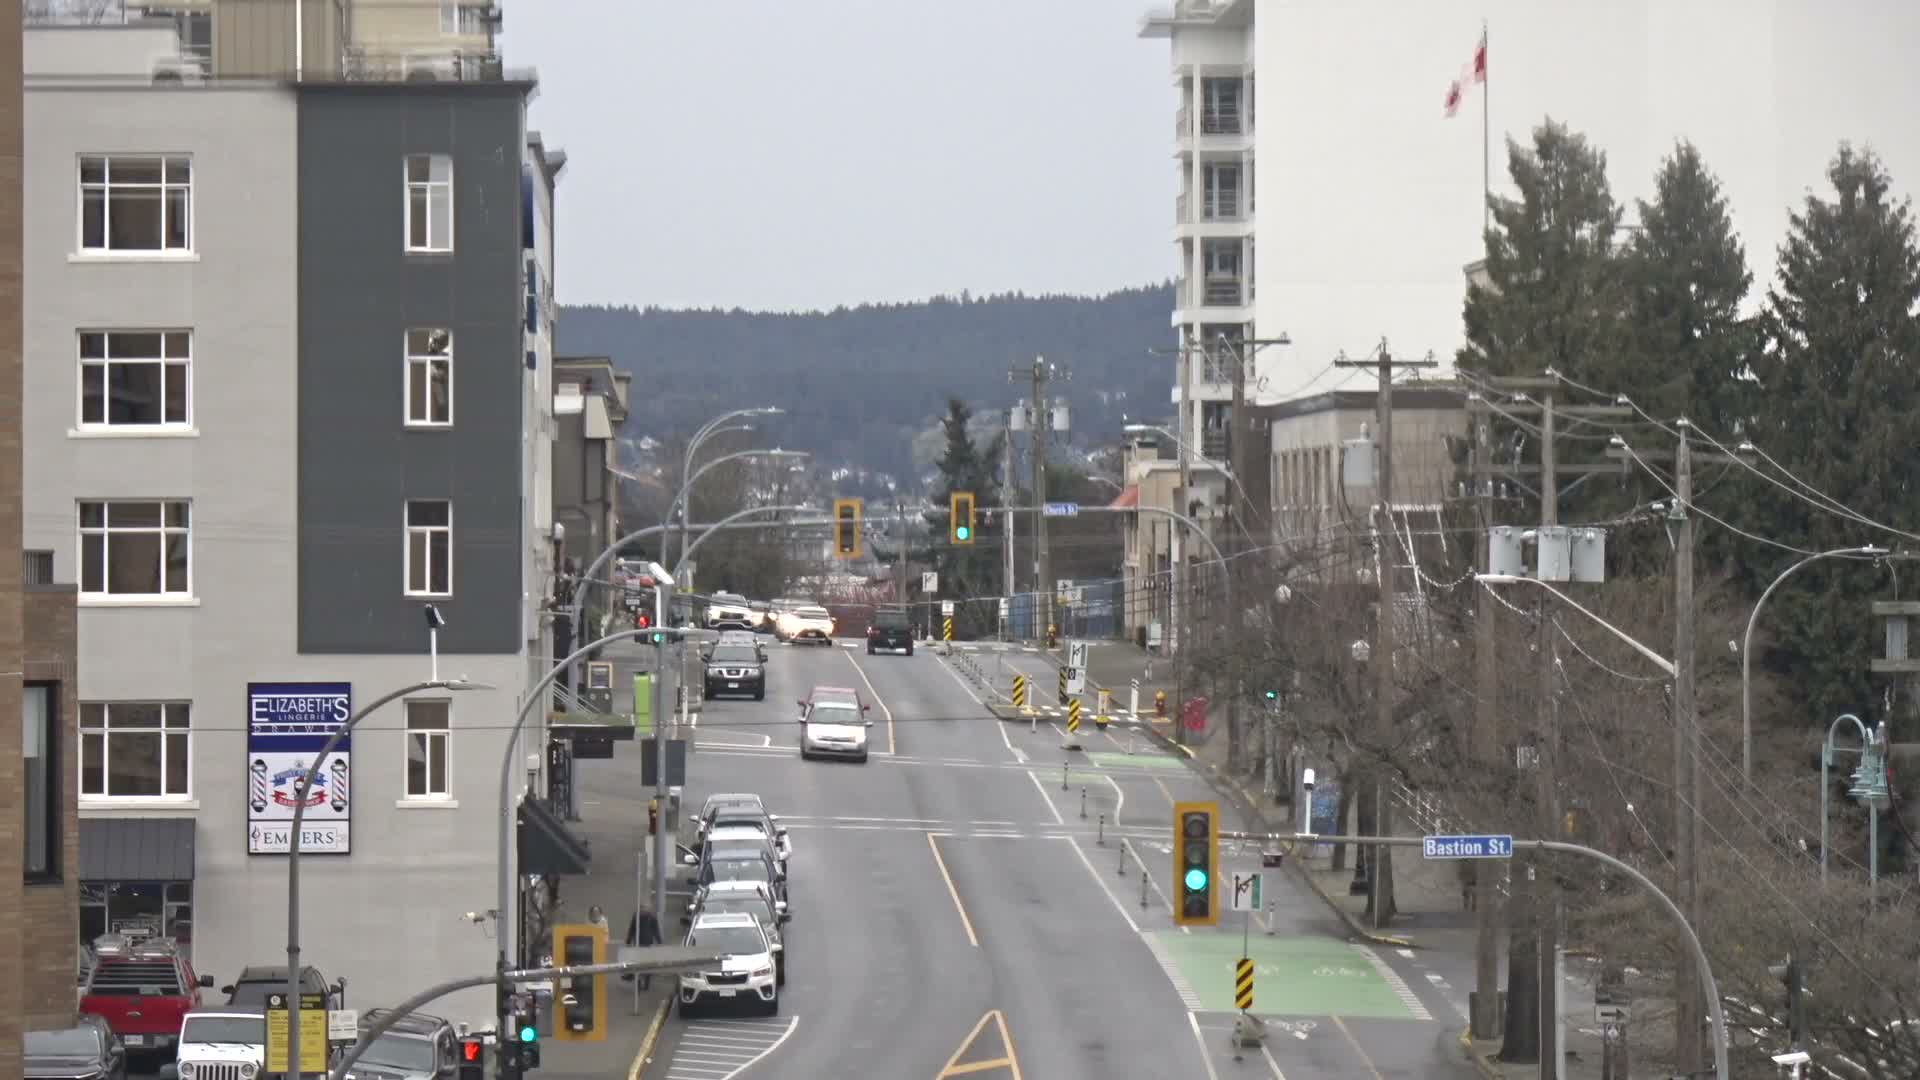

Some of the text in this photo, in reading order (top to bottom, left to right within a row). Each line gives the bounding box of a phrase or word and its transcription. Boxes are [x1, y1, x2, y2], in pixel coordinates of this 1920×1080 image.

[252, 698, 349, 721] ELIZABETH'S
[254, 725, 346, 733] DRAWE
[264, 832, 334, 844] EMERS
[1426, 838, 1510, 855] Bastion St.
